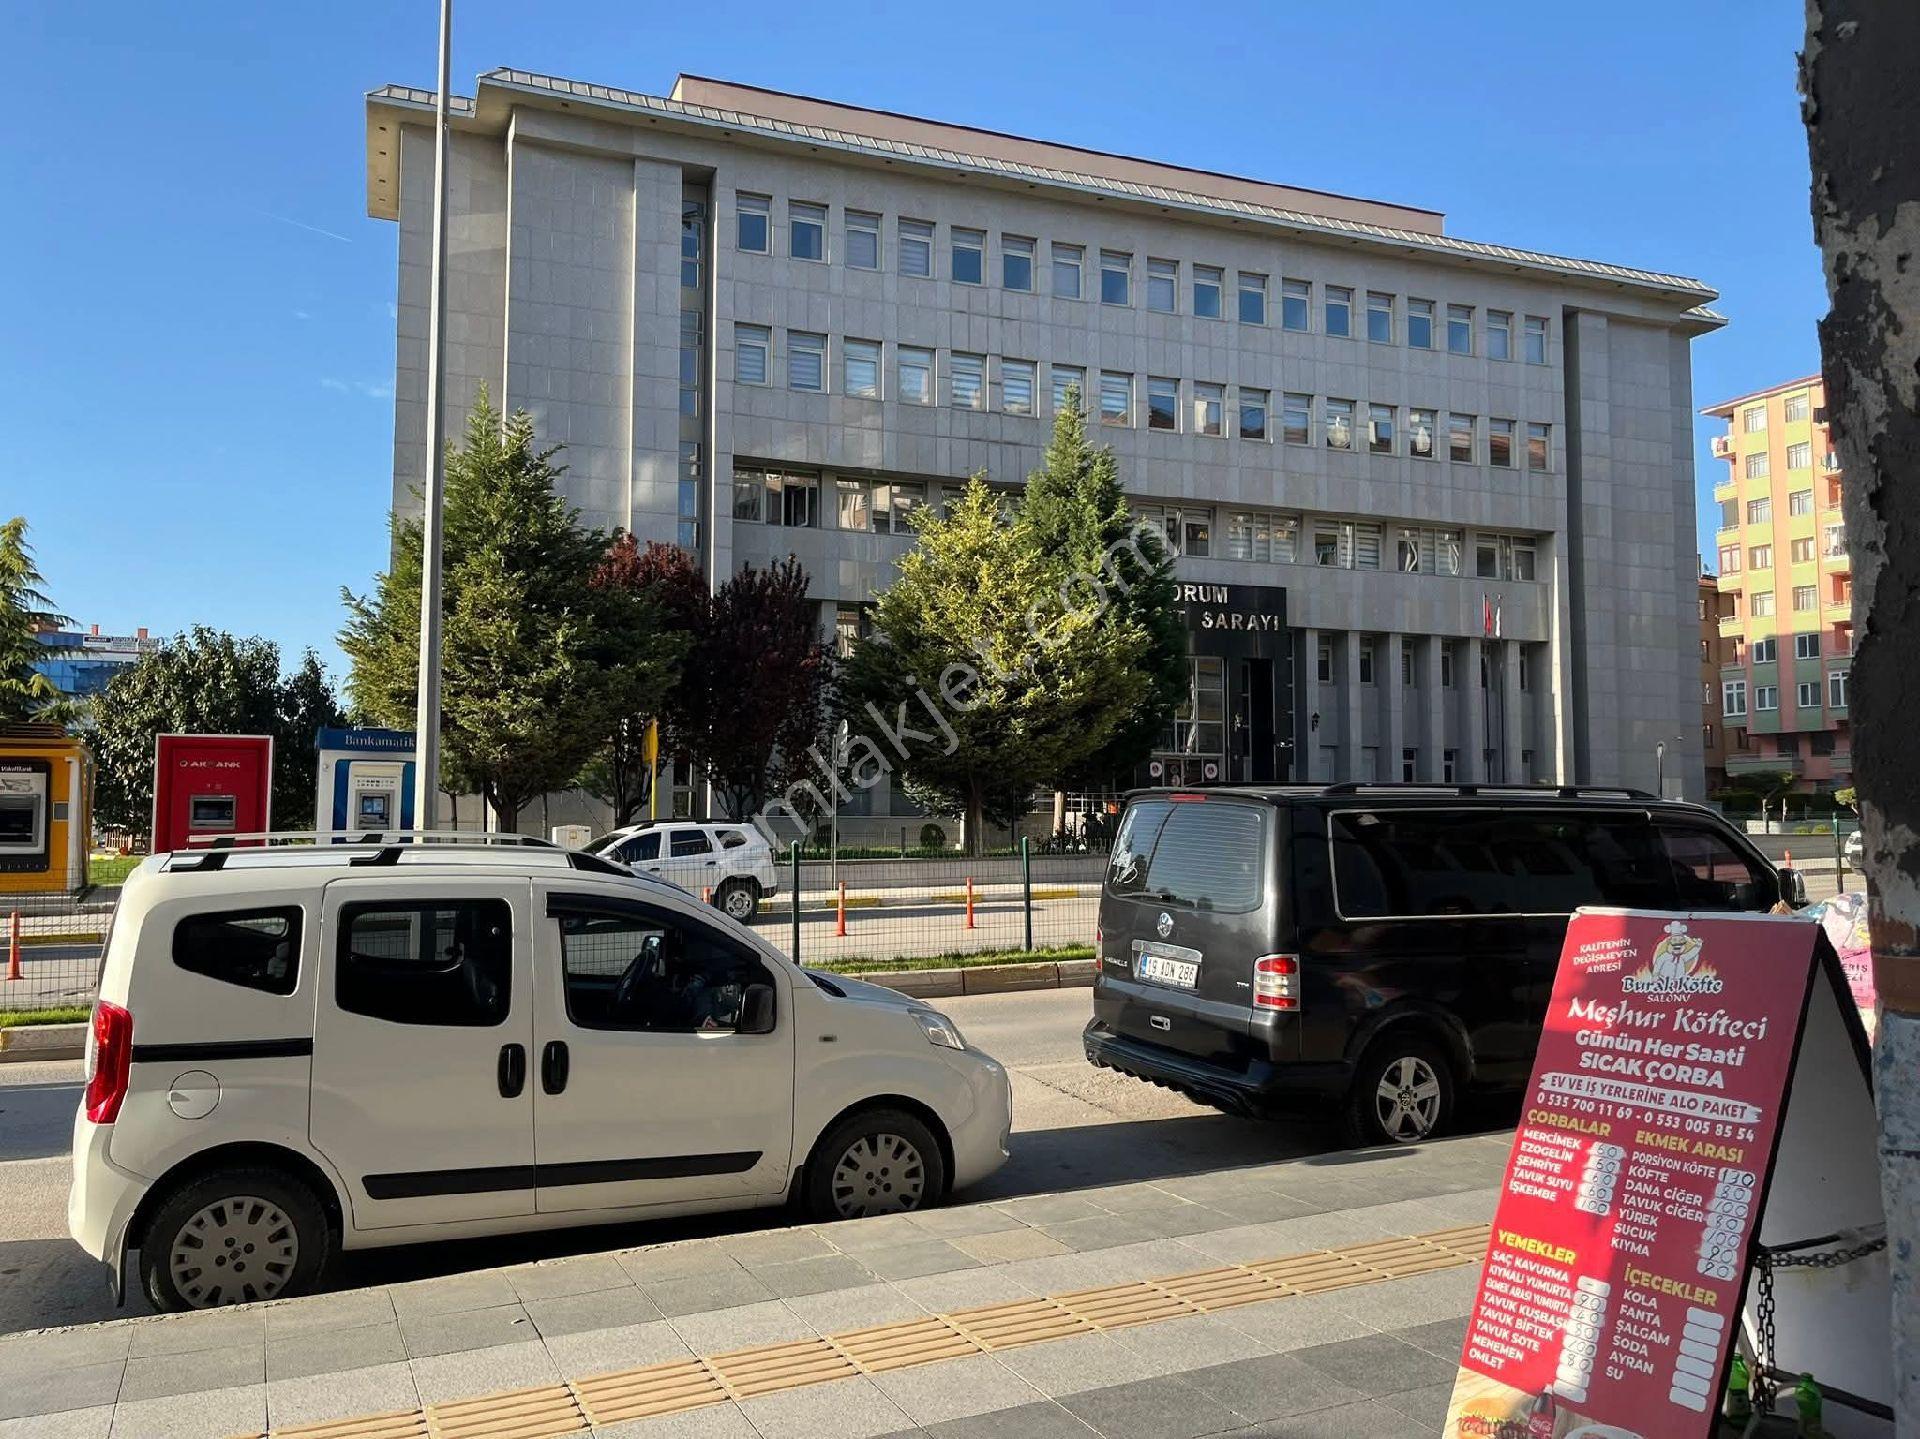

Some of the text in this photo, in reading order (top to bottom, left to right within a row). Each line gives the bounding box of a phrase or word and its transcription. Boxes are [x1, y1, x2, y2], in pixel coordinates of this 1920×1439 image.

[1170, 584, 1229, 604] ORUM
[1201, 611, 1279, 631] SARAYI
[345, 734, 415, 748] Bankamatik
[1585, 960, 1621, 973] ADRESİ
[1622, 975, 1723, 993] Burak Köfte
[1567, 997, 1769, 1040] Meşhur Köfteci
[1575, 1029, 1746, 1067] Günün Her Saati
[1578, 1051, 1725, 1089] SICAK ÇORBA
[1550, 1075, 1748, 1119] EV VE İŞ YERLERİNE ALO PAKET
[1527, 1109, 1612, 1136] ÇORBALAR
[1536, 1091, 1544, 1104] 0
[1548, 1093, 1568, 1108] 535
[1573, 1097, 1595, 1113] 700
[1599, 1102, 1612, 1117] 11
[1616, 1104, 1633, 1119] 69
[1644, 1111, 1653, 1124] 0
[1657, 1112, 1681, 1129] 553
[1685, 1118, 1711, 1134] 005
[1714, 1122, 1732, 1138] 85
[1737, 1126, 1755, 1142] 54
[1522, 1128, 1582, 1149] MERCİMEK
[1635, 1130, 1745, 1163] EKMEK ARASI
[1520, 1141, 1575, 1162] EZOGELİN
[1628, 1165, 1670, 1183] KÖFTE
[1632, 1151, 1717, 1178] PORSİYON KÖFTE
[1509, 1178, 1558, 1201] İŞKEMBE
[1513, 1167, 1573, 1191] TAVUK SUYU
[1723, 1169, 1754, 1187] 130
[1625, 1180, 1703, 1206] DANA CİĞER
[1619, 1208, 1659, 1227] YÜREK
[1622, 1193, 1704, 1223] TAVUK CİĞER
[1715, 1200, 1747, 1217] 100
[1613, 1223, 1657, 1242] SUCUK
[1708, 1230, 1740, 1248] 100
[1498, 1228, 1577, 1266] YEMEKLER
[1611, 1238, 1650, 1256] KIYMA
[1491, 1250, 1570, 1283] SAÇ KAVURMA
[1488, 1264, 1573, 1299] KIYMALI YUMURTA
[1624, 1262, 1718, 1307] İÇECEKLER
[1483, 1291, 1518, 1313] TAVUK
[1533, 1293, 1570, 1313] YUMURTA
[1623, 1289, 1658, 1310] KOLA
[1480, 1305, 1554, 1341] TAVUK BİFTEK
[1620, 1304, 1661, 1328] FANTA
[1477, 1319, 1541, 1352] TAVUK SOTE
[1616, 1319, 1670, 1346] ŞALGAM
[1472, 1333, 1524, 1361] MENEMEN
[1612, 1335, 1649, 1357] SODA
[1469, 1348, 1505, 1370] OMLET
[1609, 1350, 1655, 1375] AYRAN
[1606, 1366, 1624, 1380] SU
